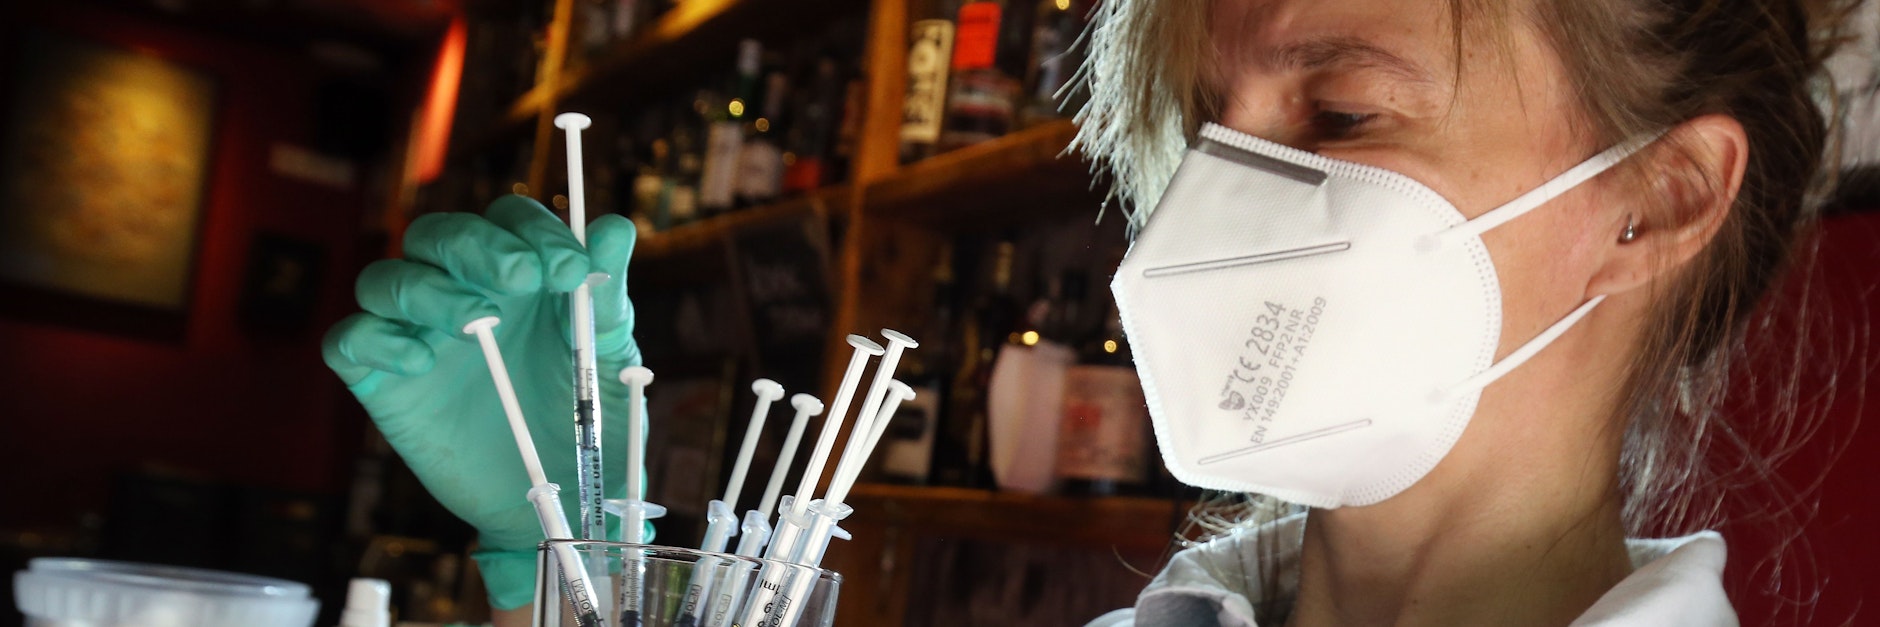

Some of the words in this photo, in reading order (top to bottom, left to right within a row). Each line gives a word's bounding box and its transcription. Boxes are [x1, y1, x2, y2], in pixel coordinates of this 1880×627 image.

[1246, 300, 1286, 356] 2834
[1243, 376, 1273, 422] YX009
[1250, 425, 1268, 444] EN
[592, 458, 601, 479] USE
[594, 482, 603, 526] SINGLE
[771, 600, 789, 627] OL-M
